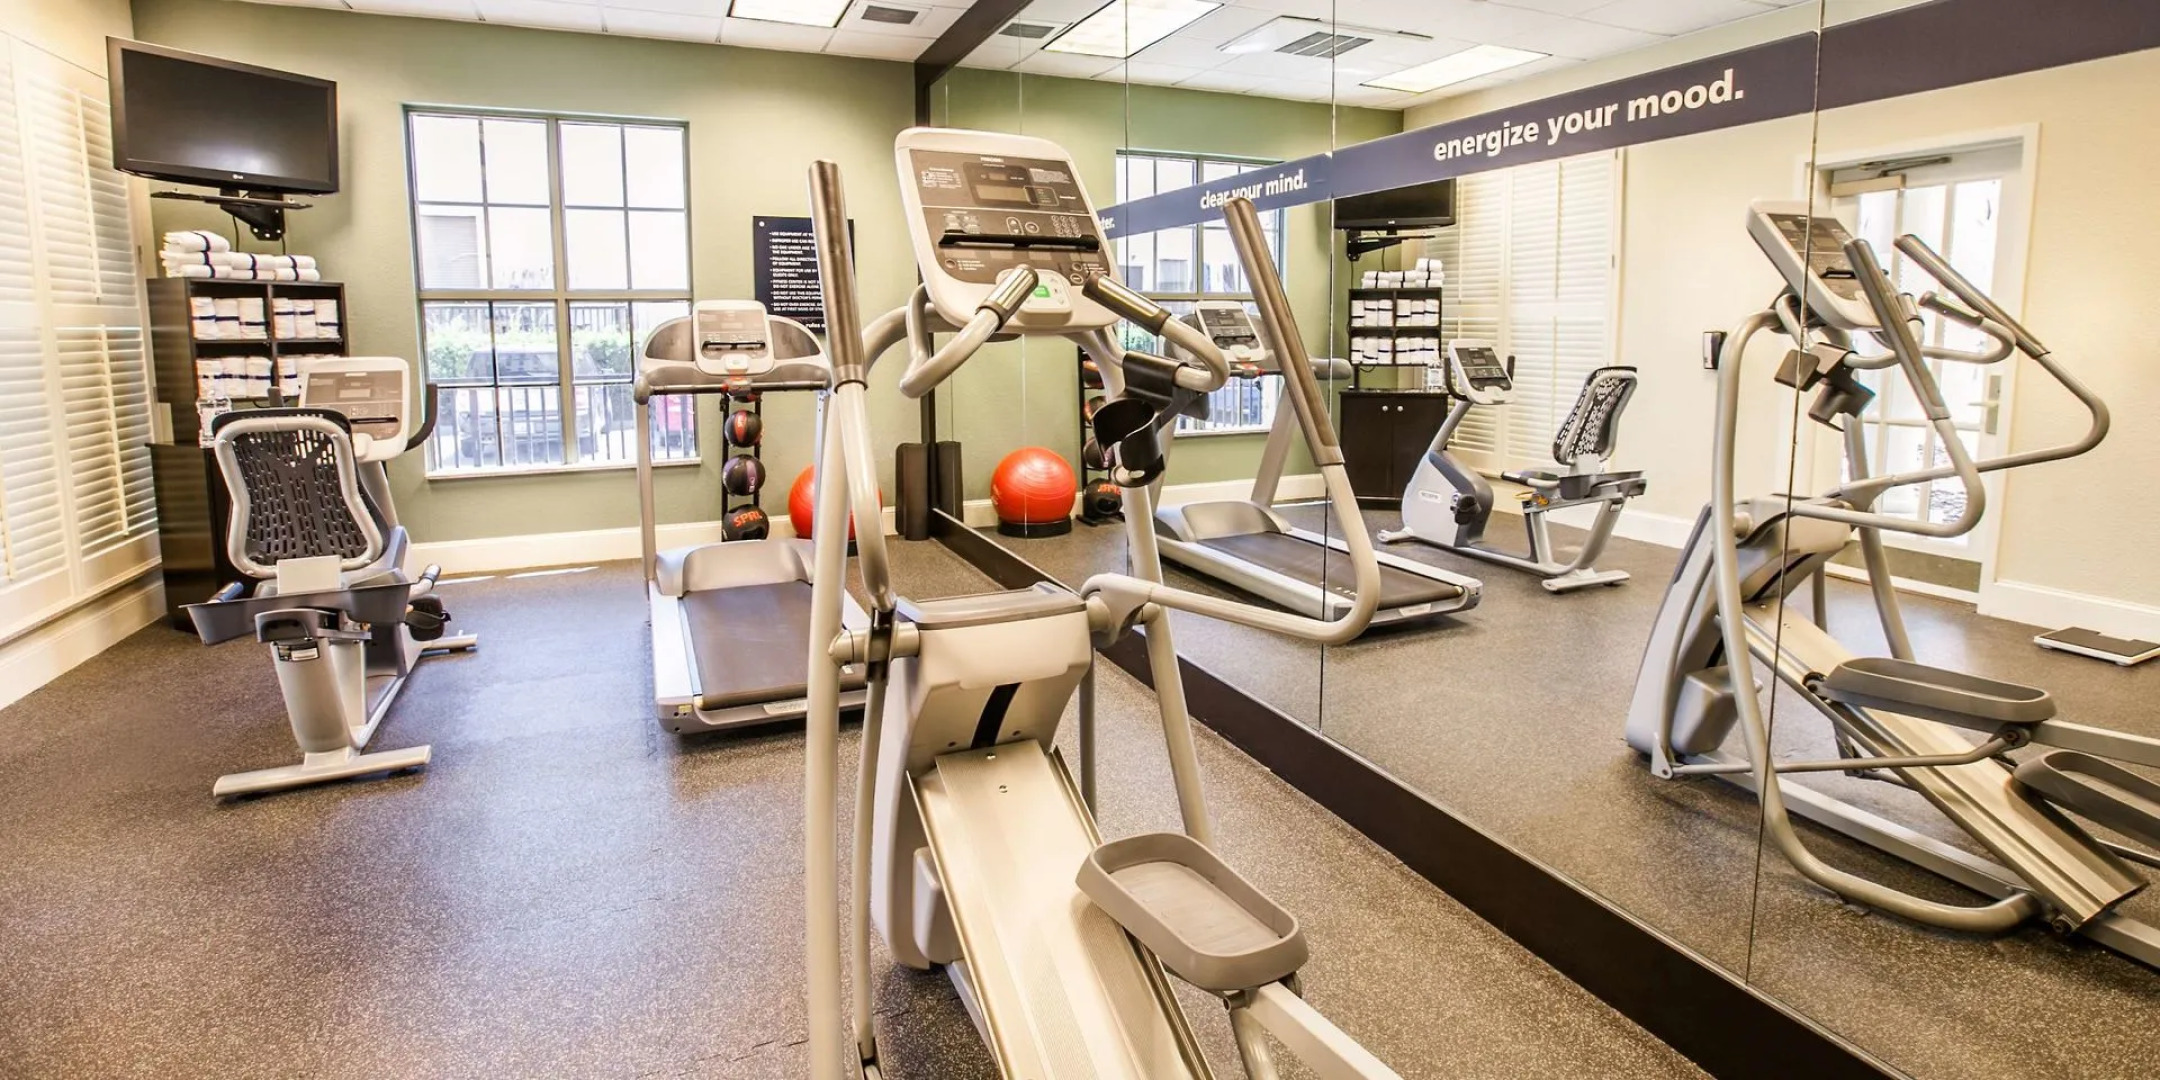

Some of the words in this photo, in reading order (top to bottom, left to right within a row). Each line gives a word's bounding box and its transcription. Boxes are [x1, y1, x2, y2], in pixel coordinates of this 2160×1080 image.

[1433, 120, 1539, 161] energize
[1547, 102, 1619, 145] your
[1626, 68, 1744, 122] mood.
[1200, 190, 1230, 209] clear
[1265, 168, 1308, 196] mind.
